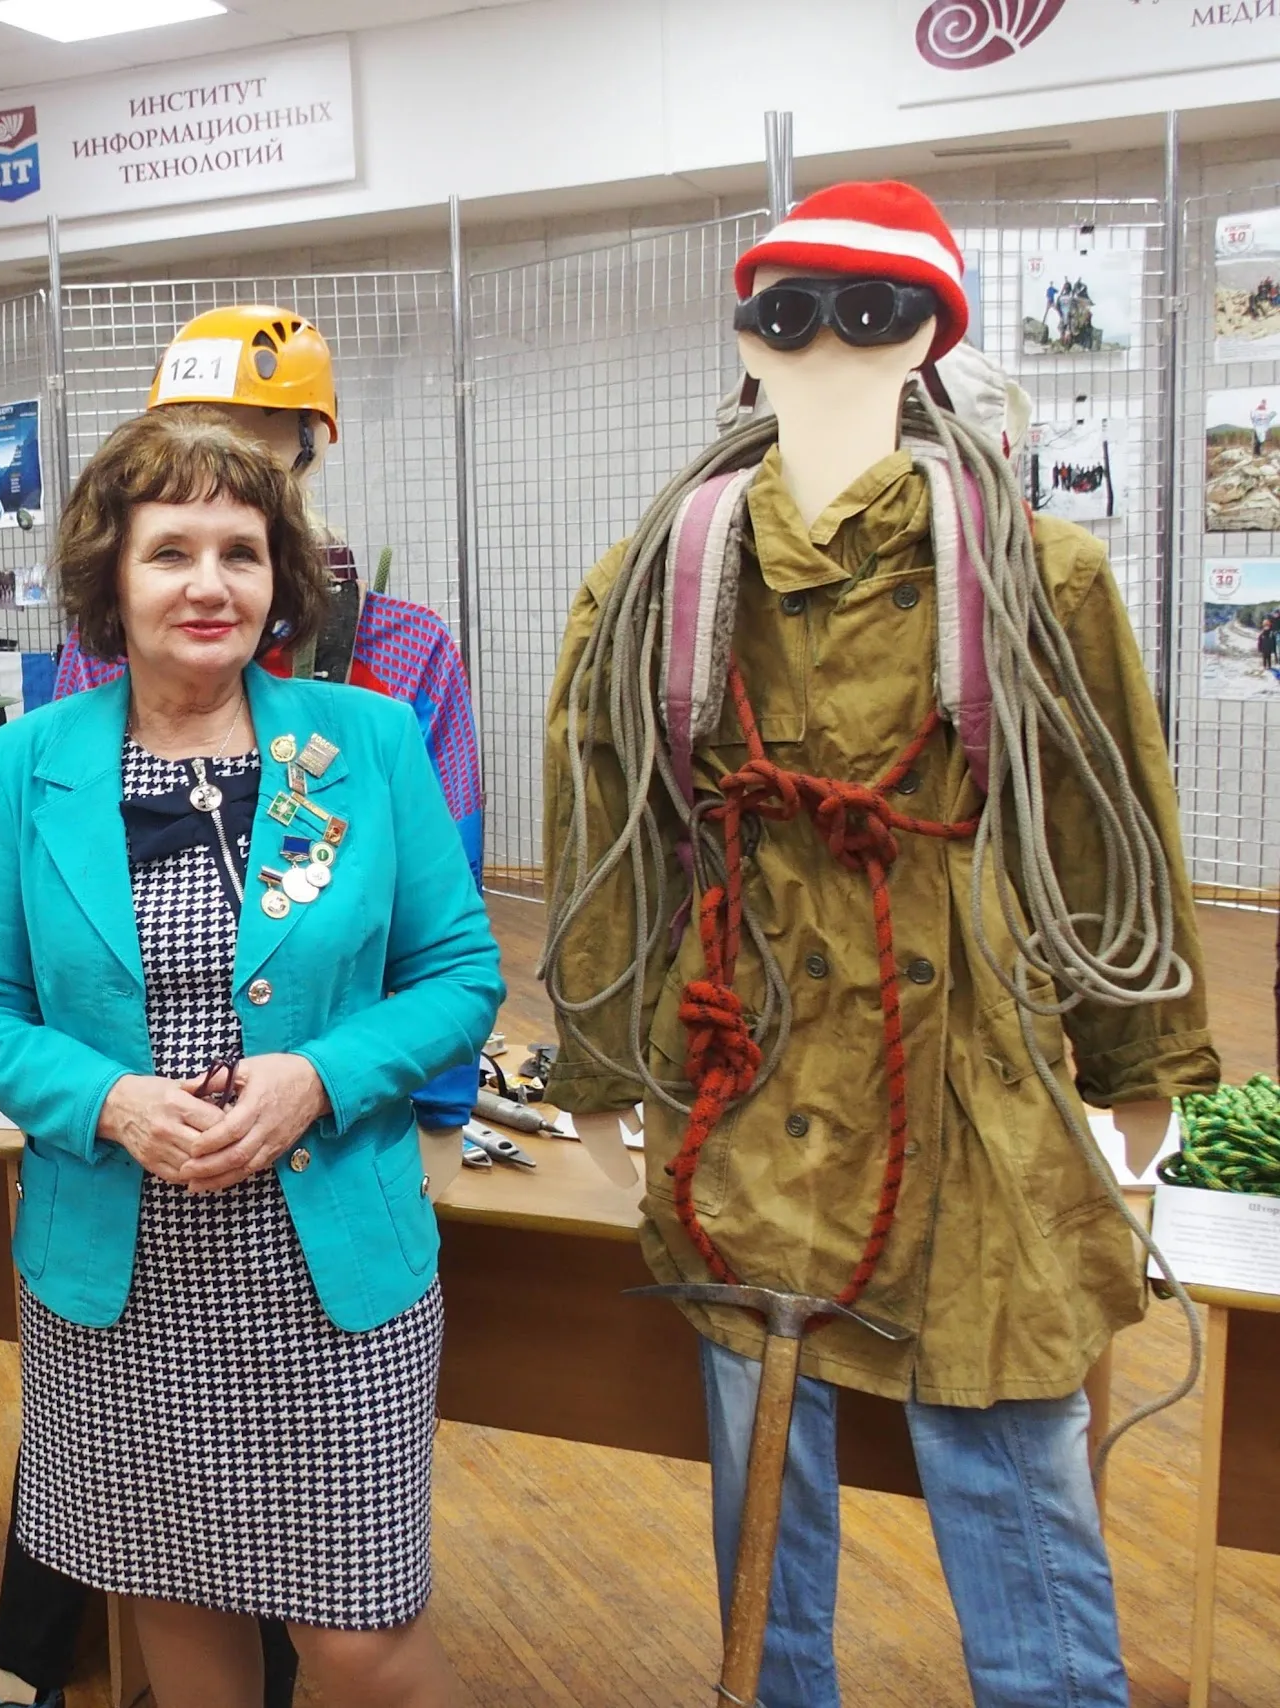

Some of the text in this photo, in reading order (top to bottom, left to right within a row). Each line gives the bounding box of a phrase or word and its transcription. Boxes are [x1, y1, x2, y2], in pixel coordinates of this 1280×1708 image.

[1189, 0, 1280, 28] МЕДИ
[128, 77, 268, 118] ИНСТИТУТ
[72, 101, 333, 160] ИНФОРМАЦИОННЫХ
[119, 138, 285, 185] ТЕХНОЛОГИЙ
[170, 356, 223, 381] 12.1
